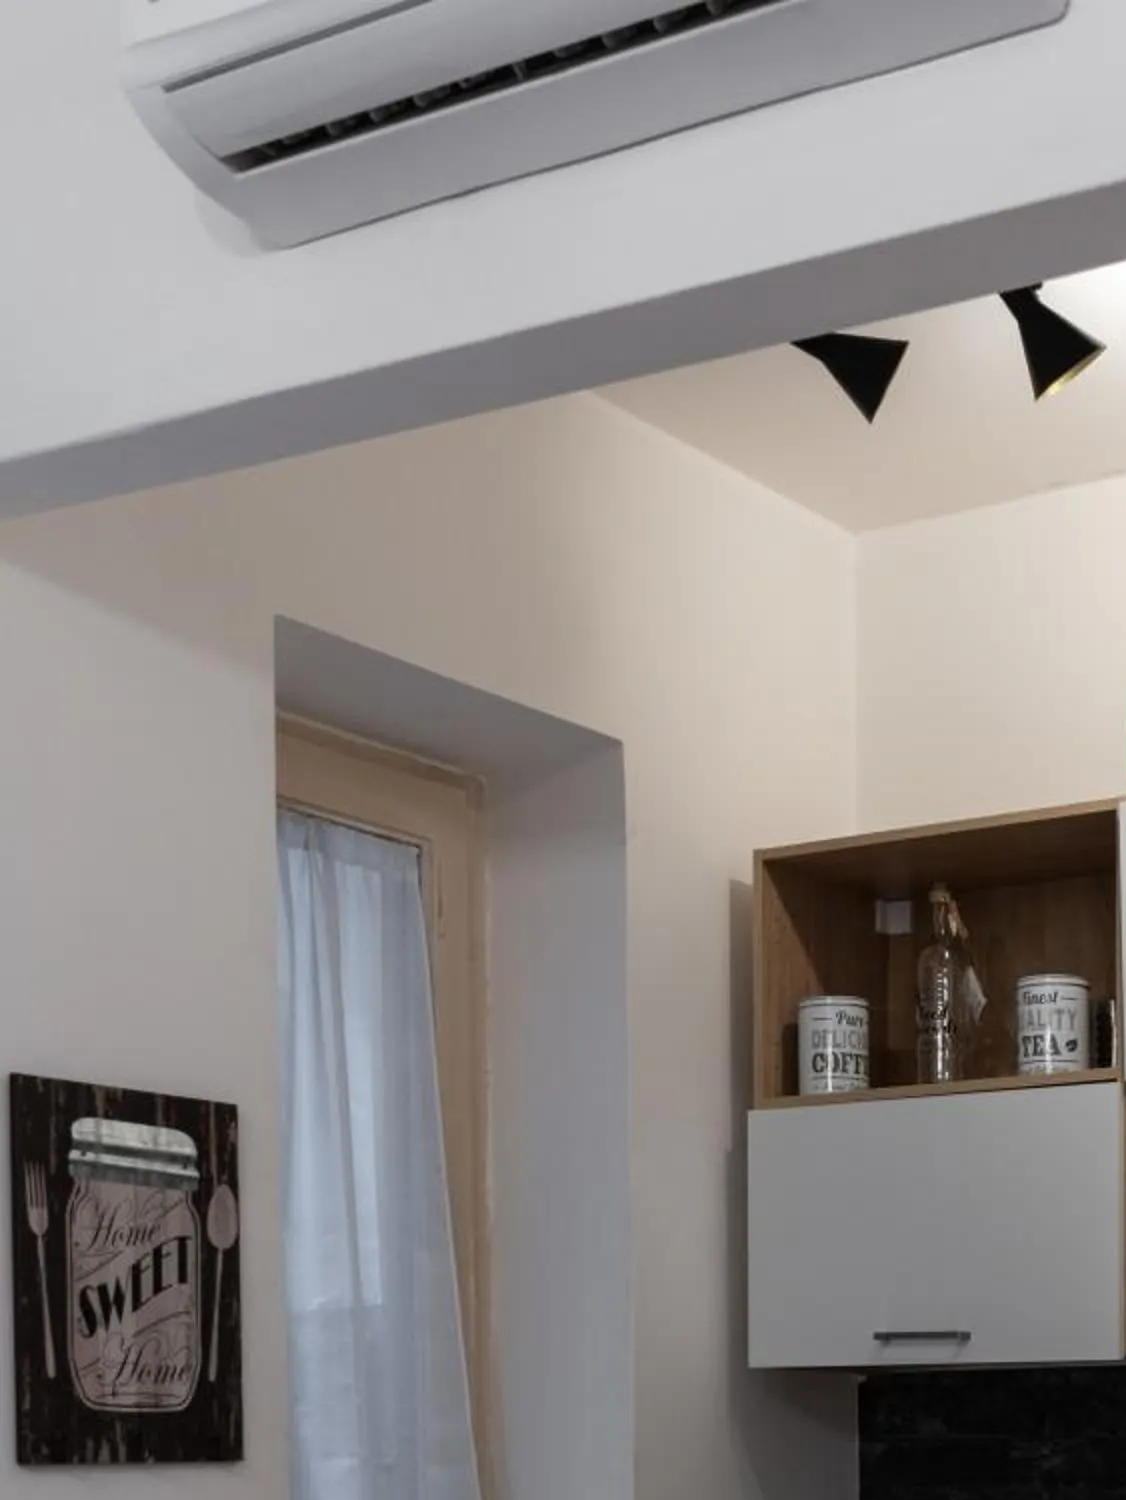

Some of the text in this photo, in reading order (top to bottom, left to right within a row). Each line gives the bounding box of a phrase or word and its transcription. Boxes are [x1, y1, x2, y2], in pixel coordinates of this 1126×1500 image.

[1021, 1008, 1077, 1032] ALITY
[1021, 1032, 1062, 1058] TEA
[74, 1199, 161, 1252] Home
[77, 1236, 192, 1339] SWEET
[97, 1340, 191, 1391] Home
